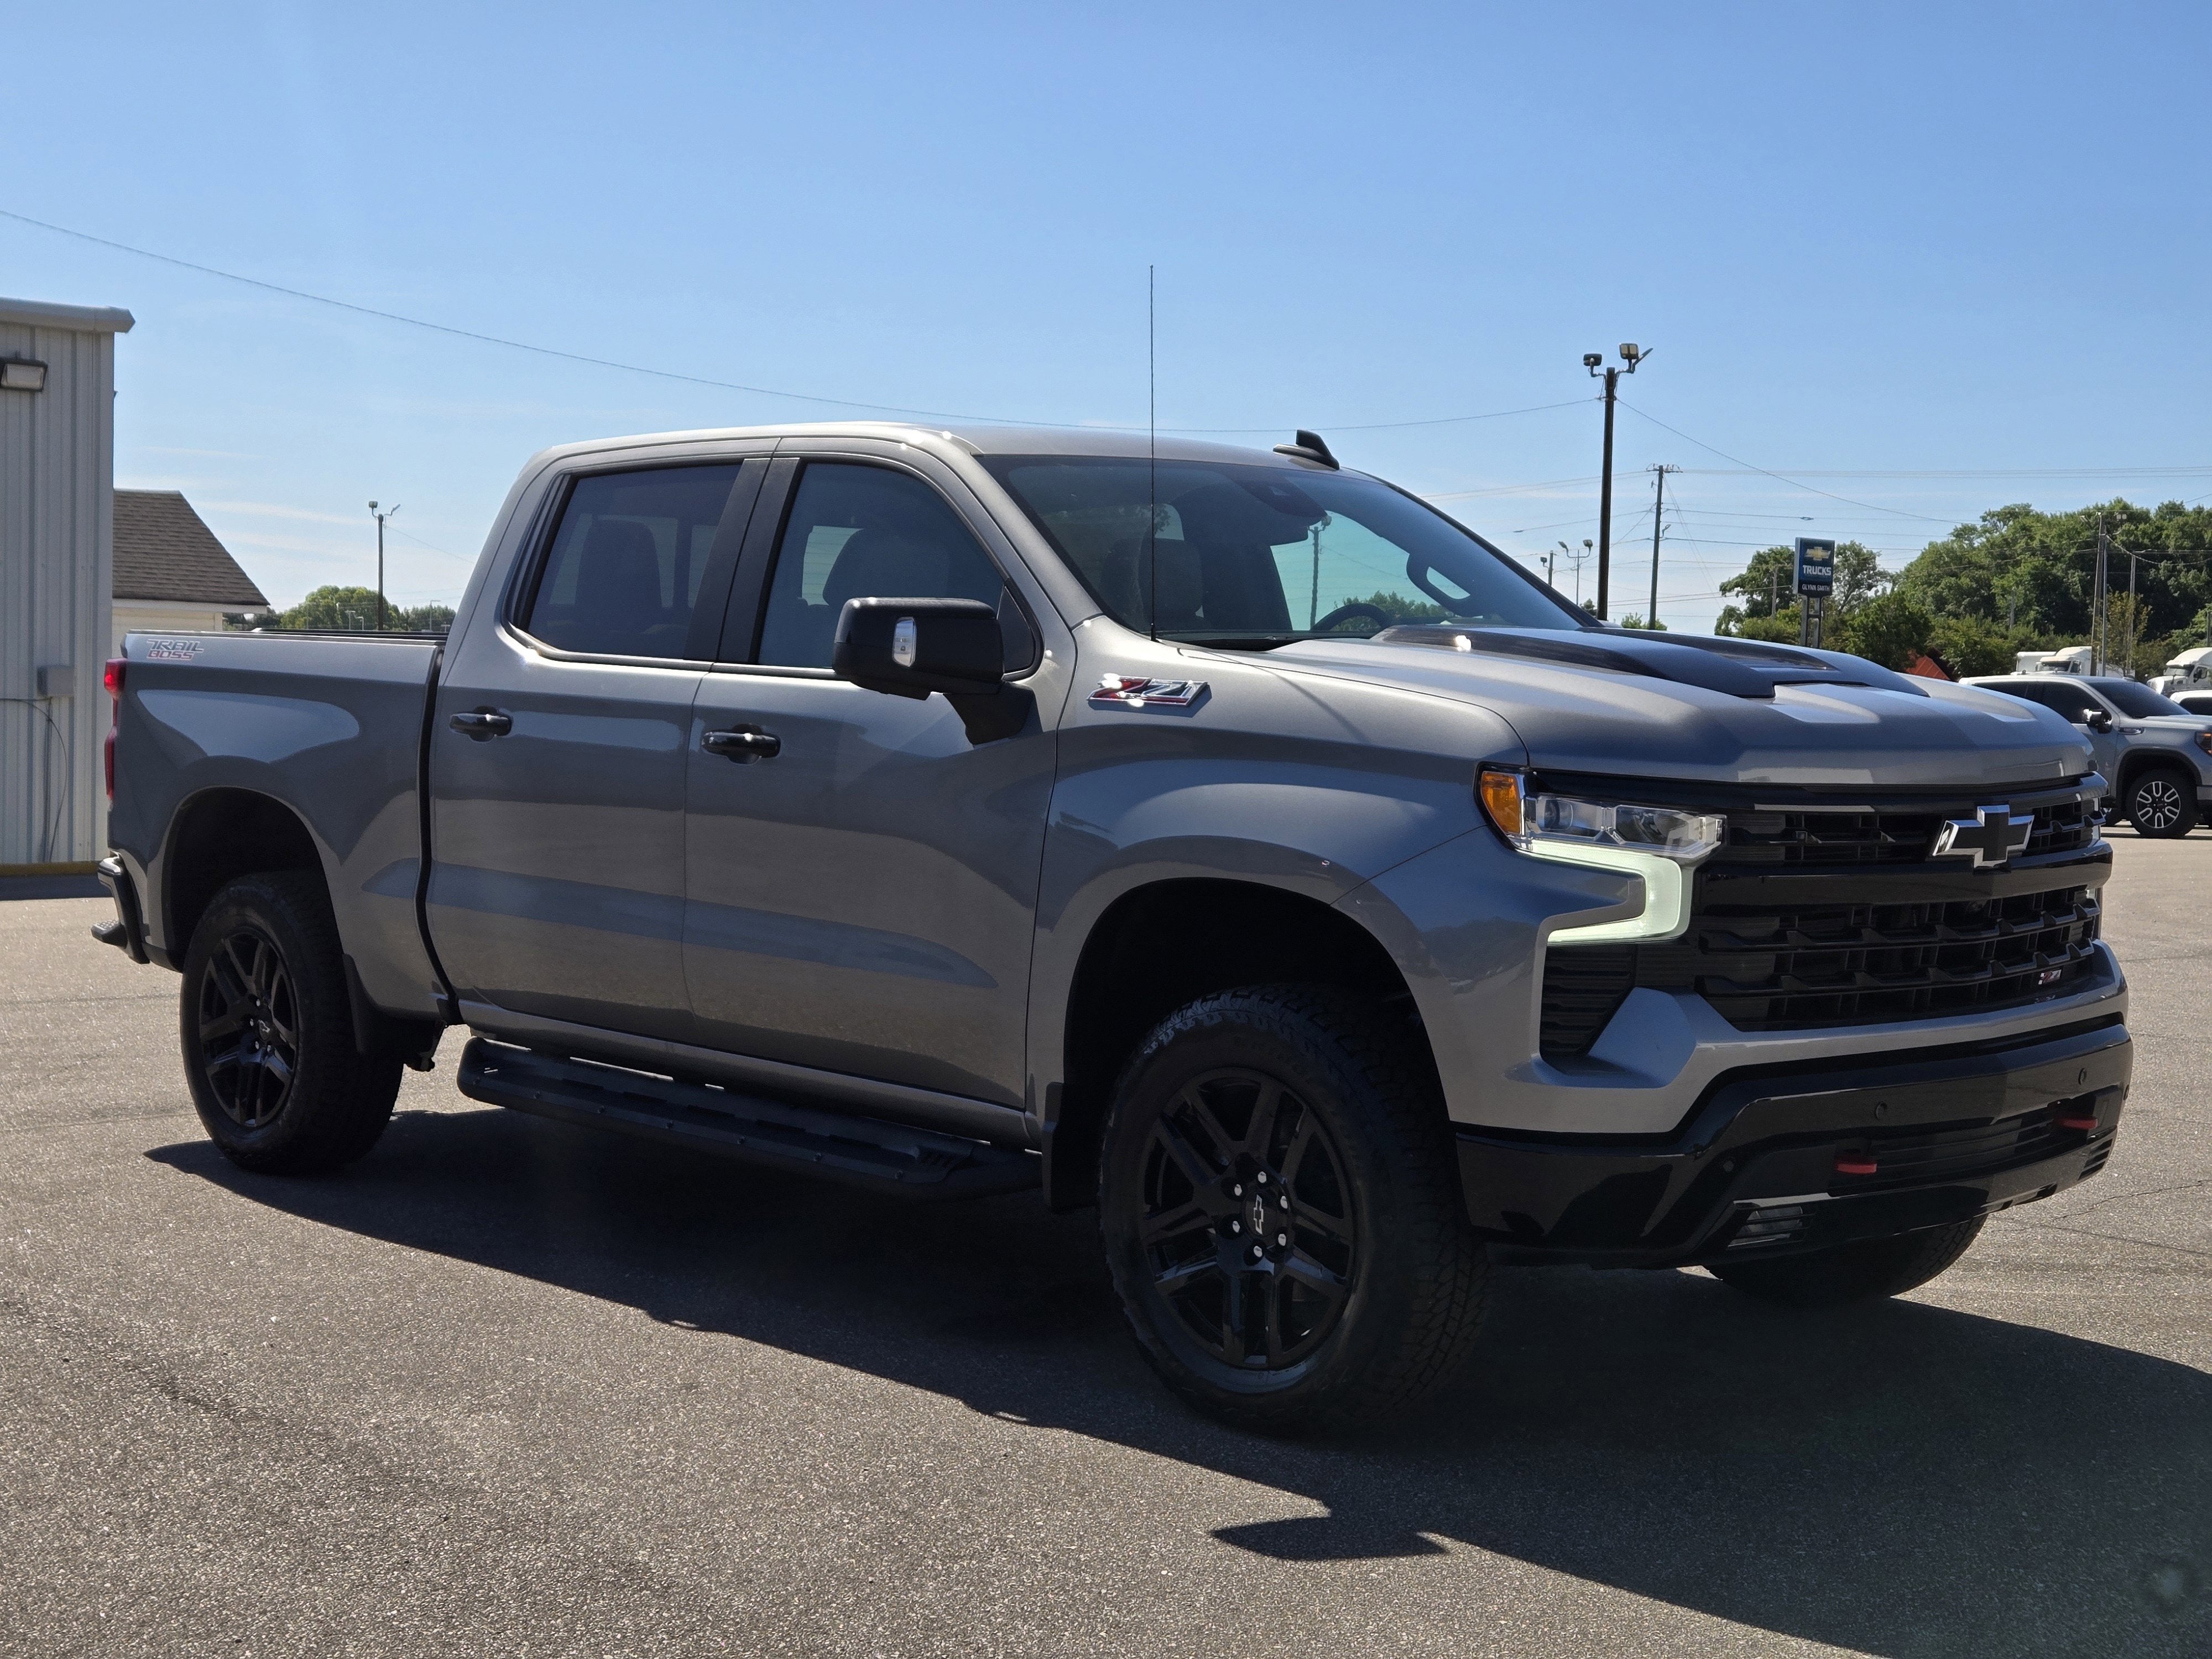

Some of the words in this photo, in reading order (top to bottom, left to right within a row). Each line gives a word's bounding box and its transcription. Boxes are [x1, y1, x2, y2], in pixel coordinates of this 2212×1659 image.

[1803, 565, 1832, 576] TRUCKS
[147, 639, 205, 653] TRAIL
[147, 650, 194, 660] BOSS
[1086, 673, 1208, 707] Z71
